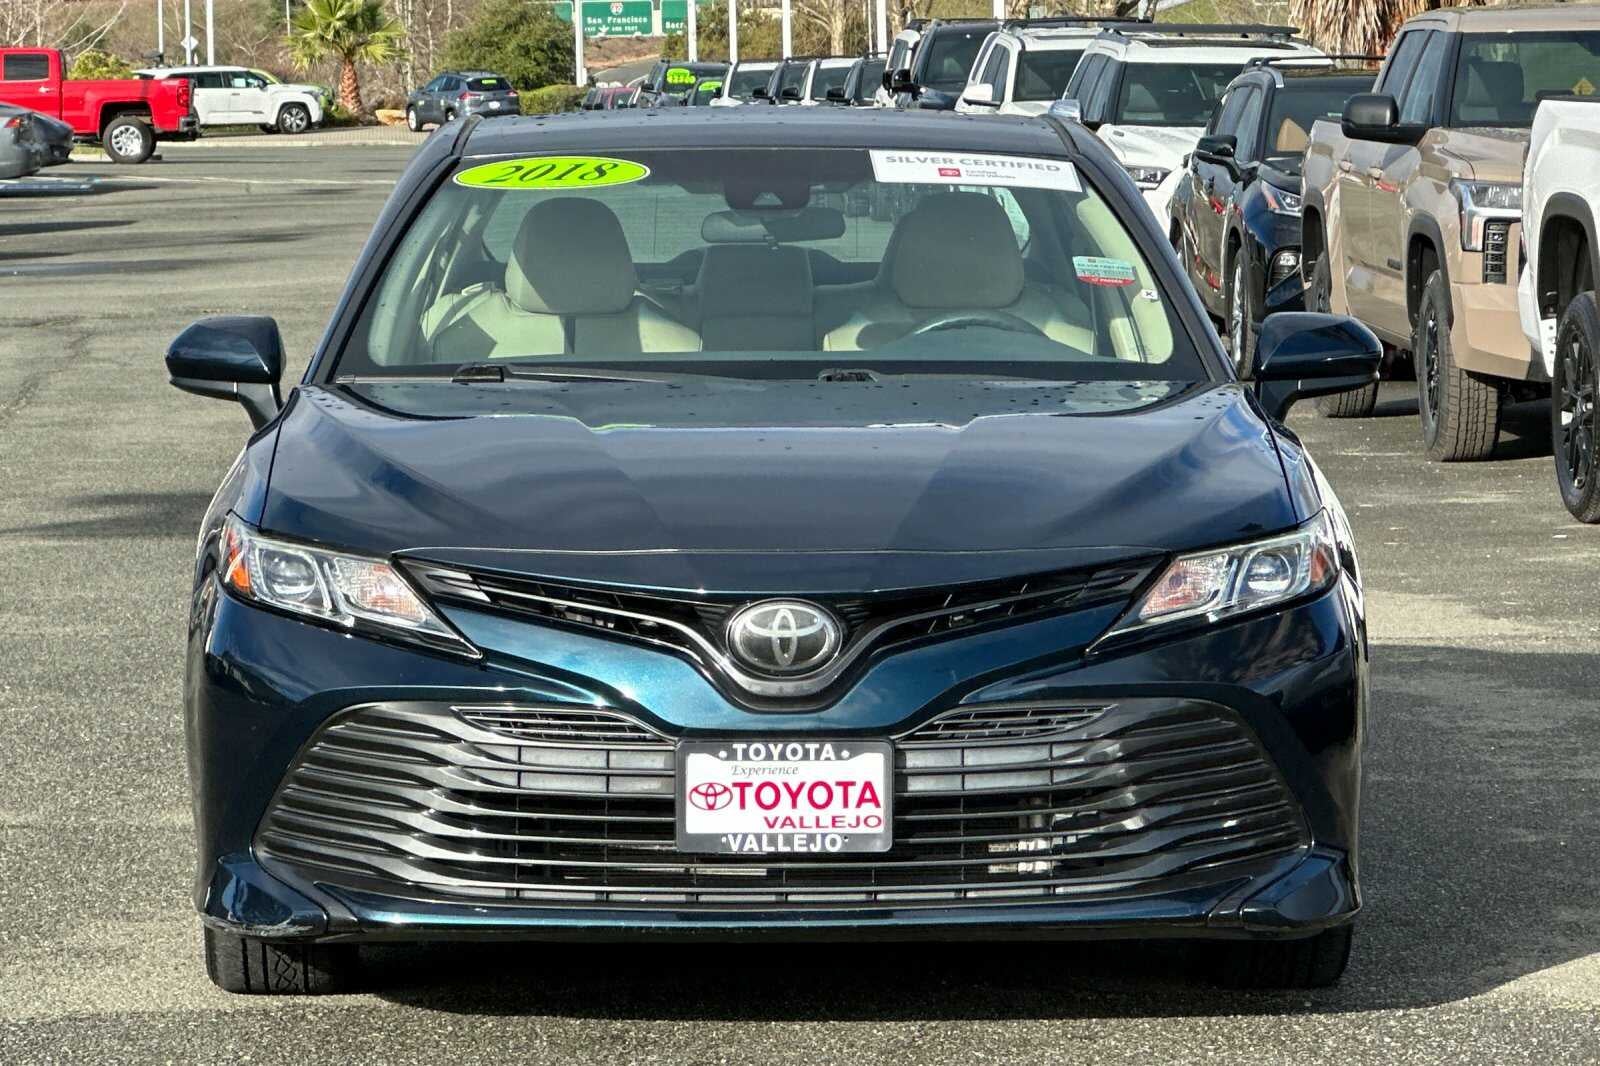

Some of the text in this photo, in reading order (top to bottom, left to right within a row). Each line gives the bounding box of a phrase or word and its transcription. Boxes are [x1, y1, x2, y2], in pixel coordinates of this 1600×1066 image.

[587, 15, 648, 24] San Francisco
[885, 155, 1061, 172] SILVER CERTIFIED
[482, 162, 619, 183] 2018
[732, 743, 836, 761] TOYOTA
[730, 764, 799, 778] Experience
[732, 780, 881, 810] TOYOTA
[763, 815, 882, 829] VALLEJO
[728, 833, 842, 852] VALLEJO
